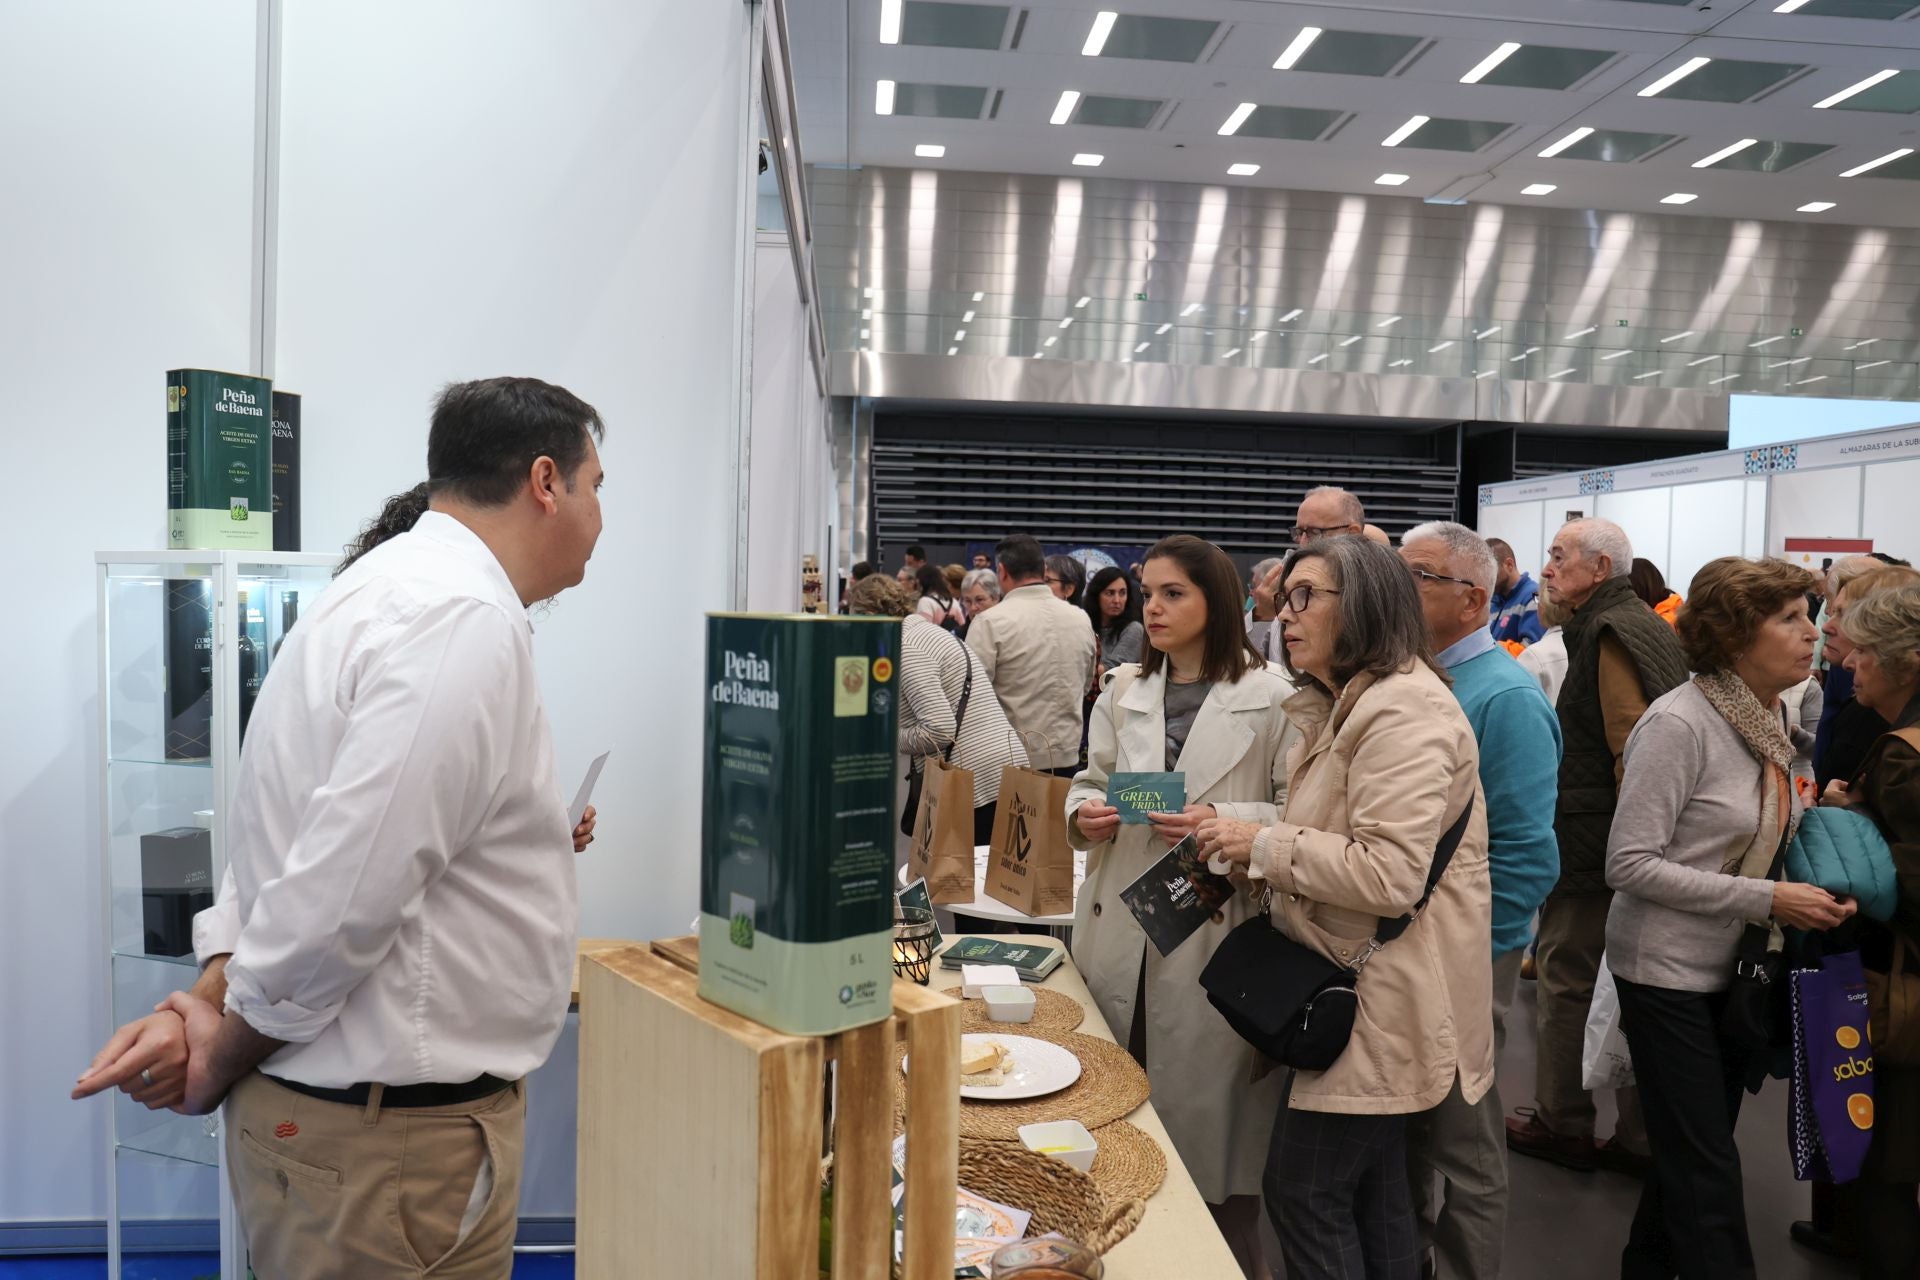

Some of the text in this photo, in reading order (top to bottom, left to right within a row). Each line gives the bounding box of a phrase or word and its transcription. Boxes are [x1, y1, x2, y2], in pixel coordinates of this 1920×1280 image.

[222, 387, 256, 404] Peña
[271, 420, 291, 430] ONA
[272, 428, 293, 439] AENA
[1840, 442, 1881, 454] ALMAZARAS
[1881, 440, 1893, 450] DE
[1893, 439, 1904, 448] LA
[724, 650, 770, 683] Peña
[1120, 791, 1163, 802] GREEN
[1131, 801, 1168, 810] FRIDAY
[1167, 876, 1185, 893] Peña
[1833, 1056, 1873, 1082] sabo
